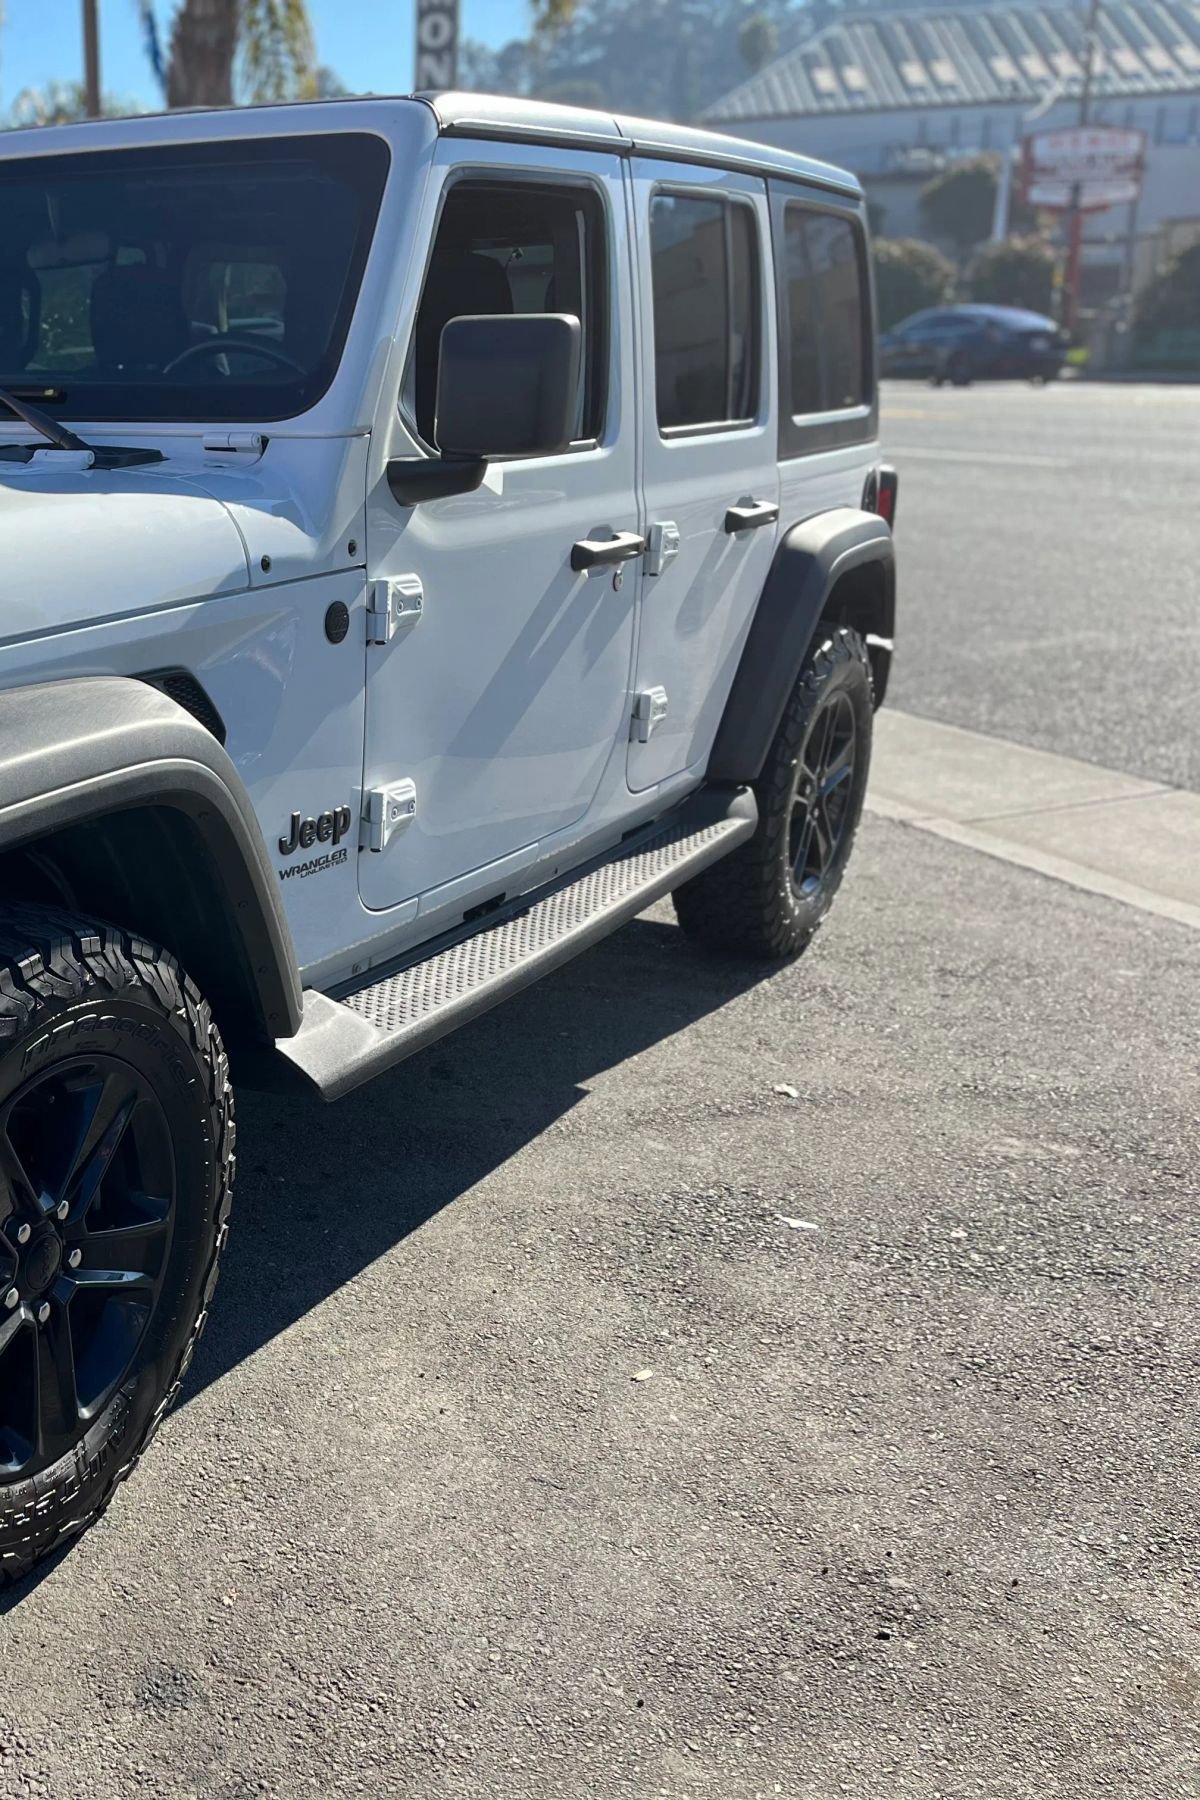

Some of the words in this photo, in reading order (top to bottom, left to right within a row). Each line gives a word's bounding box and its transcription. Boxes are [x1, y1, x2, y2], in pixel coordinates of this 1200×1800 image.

[419, 0, 453, 90] ON
[278, 804, 351, 856] Jeep
[278, 848, 348, 881] WRANGLER
[300, 856, 348, 878] UNLIMITED
